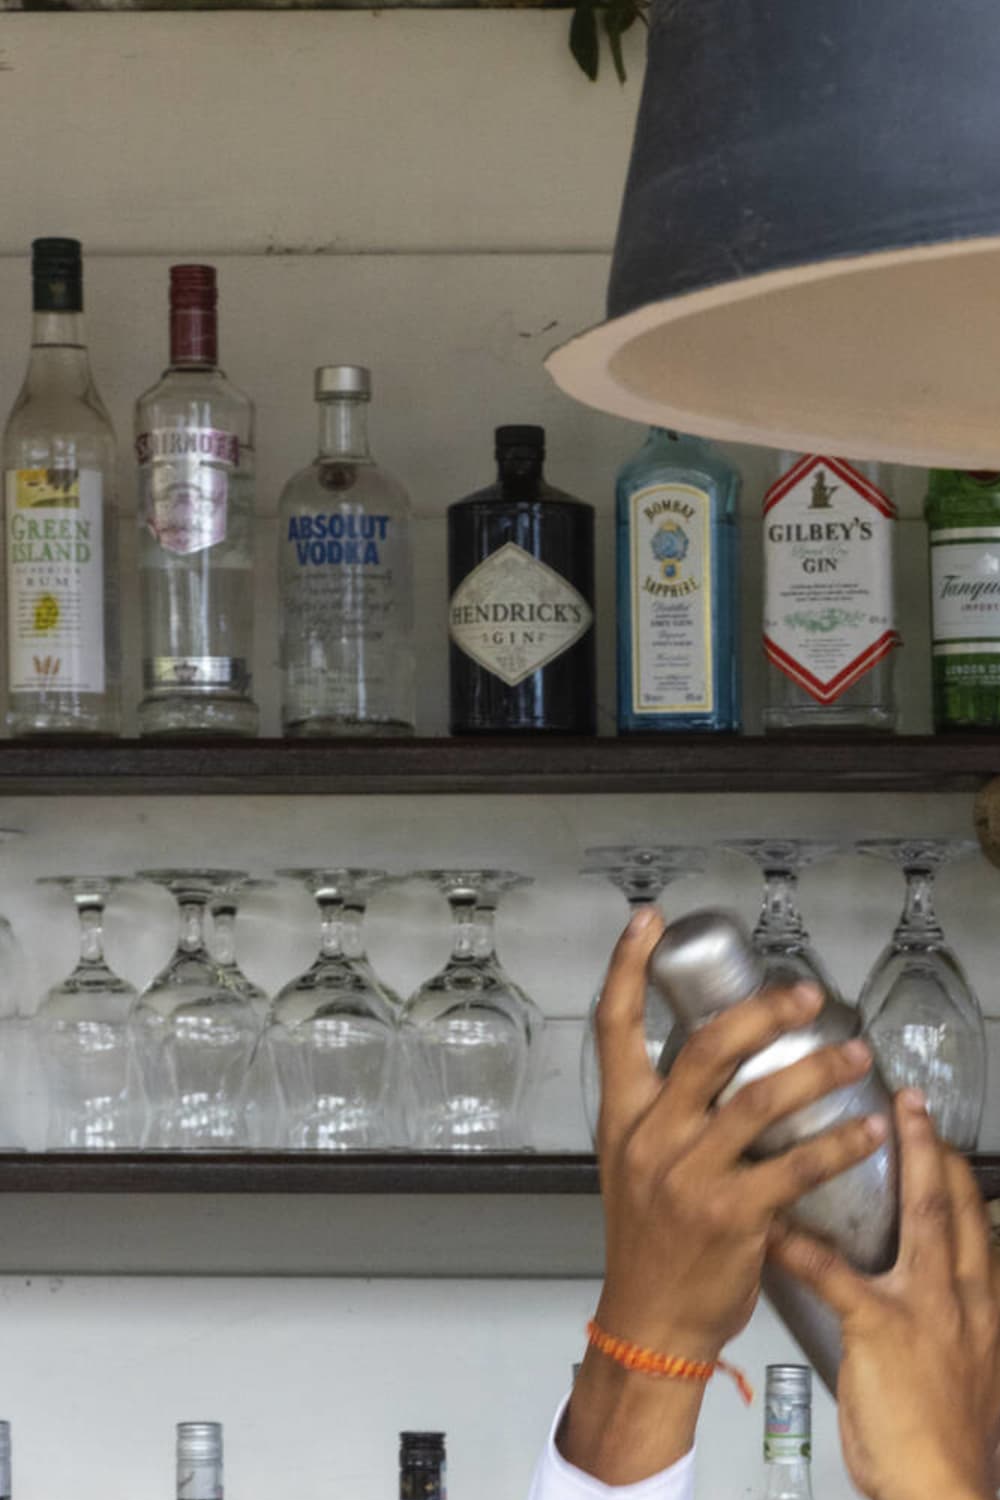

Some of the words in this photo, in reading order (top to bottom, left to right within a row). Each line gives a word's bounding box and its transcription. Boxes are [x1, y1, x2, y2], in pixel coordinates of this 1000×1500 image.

[643, 500, 696, 523] BOMBAY
[11, 513, 91, 541] GREEN
[288, 513, 390, 541] ABSOLUT
[768, 517, 873, 543] GILBEY'S
[11, 542, 91, 564] ISLAND
[297, 540, 379, 566] VODKA
[802, 557, 838, 574] GIN
[642, 576, 699, 598] SAPPHIRE
[452, 602, 582, 625] HENDRICK'S
[492, 630, 534, 645] GIN
